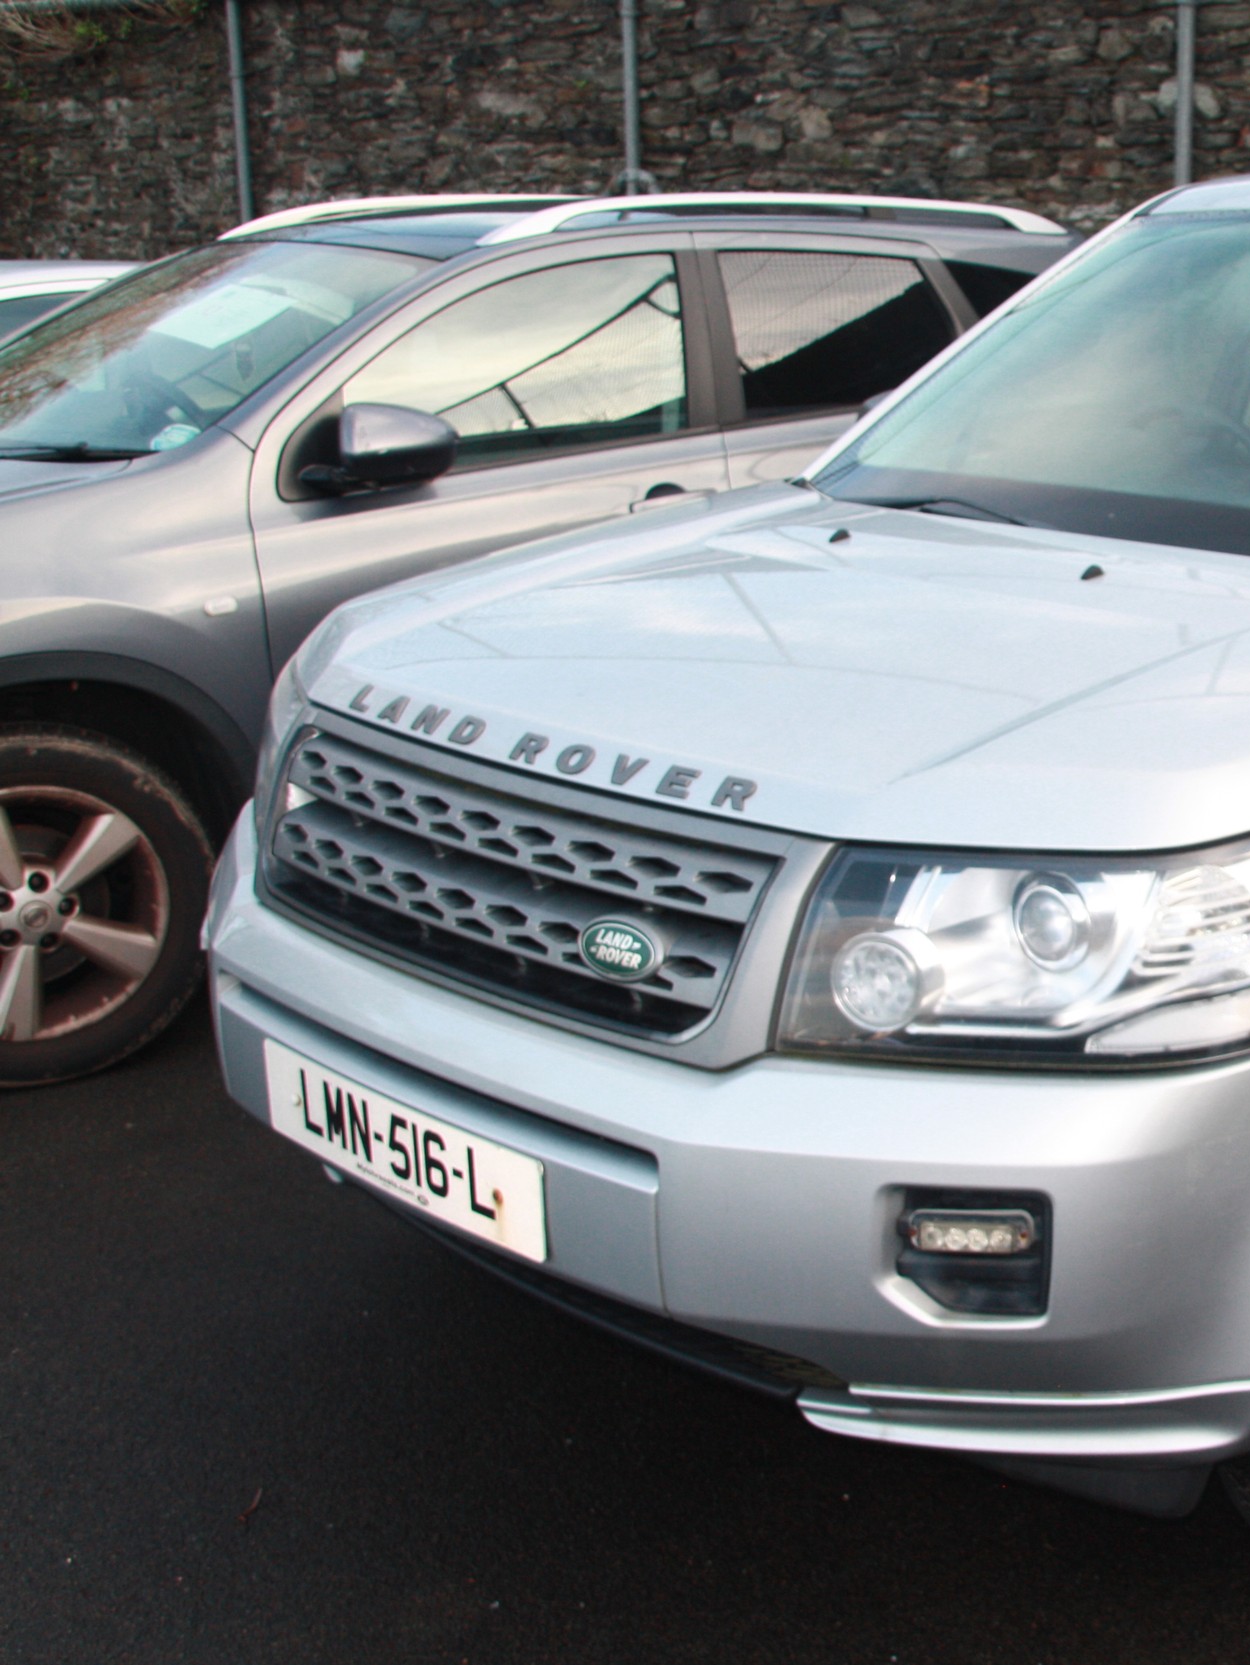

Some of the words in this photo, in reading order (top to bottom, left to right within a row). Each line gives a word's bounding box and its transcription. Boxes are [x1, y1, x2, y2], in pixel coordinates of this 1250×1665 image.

[349, 684, 487, 746] LAND
[509, 732, 758, 811] ROVER
[300, 1067, 497, 1221] LMN-516-L
